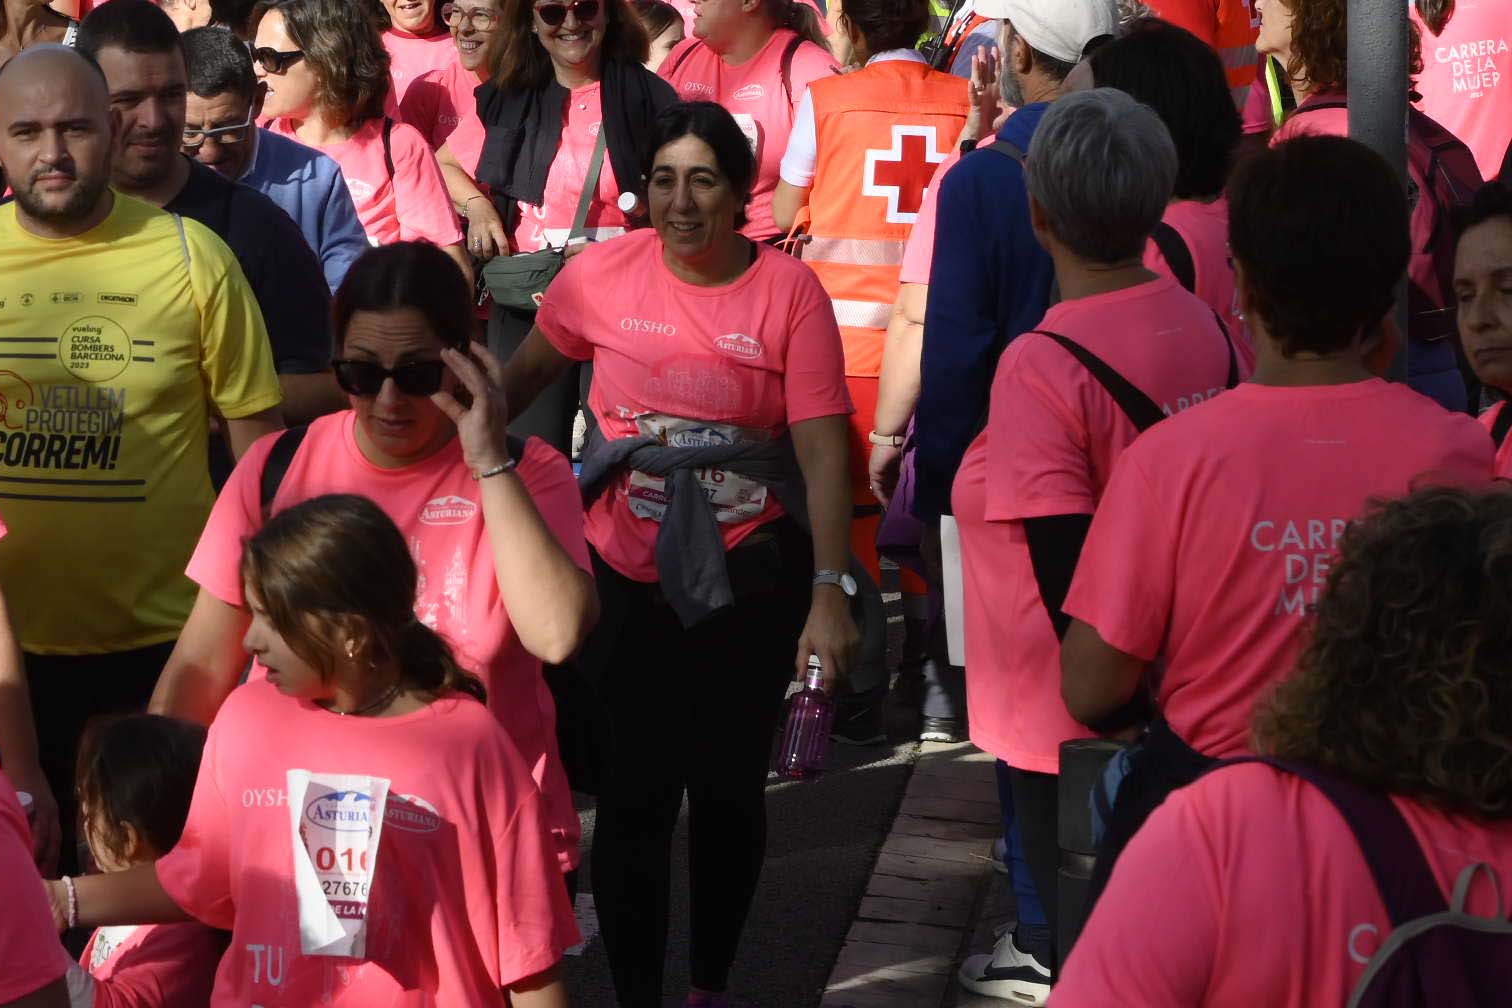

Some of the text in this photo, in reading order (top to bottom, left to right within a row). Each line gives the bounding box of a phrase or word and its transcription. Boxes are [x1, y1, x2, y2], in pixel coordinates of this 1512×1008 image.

[1435, 38, 1509, 63] CARRERA
[1453, 56, 1497, 77] DE LA
[72, 324, 102, 335] vueling
[620, 318, 676, 337] OYSHO
[71, 343, 115, 353] BOMBERS
[72, 335, 101, 344] CURSA
[70, 353, 125, 362] BARCELONA
[38, 385, 126, 410] VETLLEM
[26, 408, 125, 435] PROTEGIM
[246, 943, 283, 986] TU
